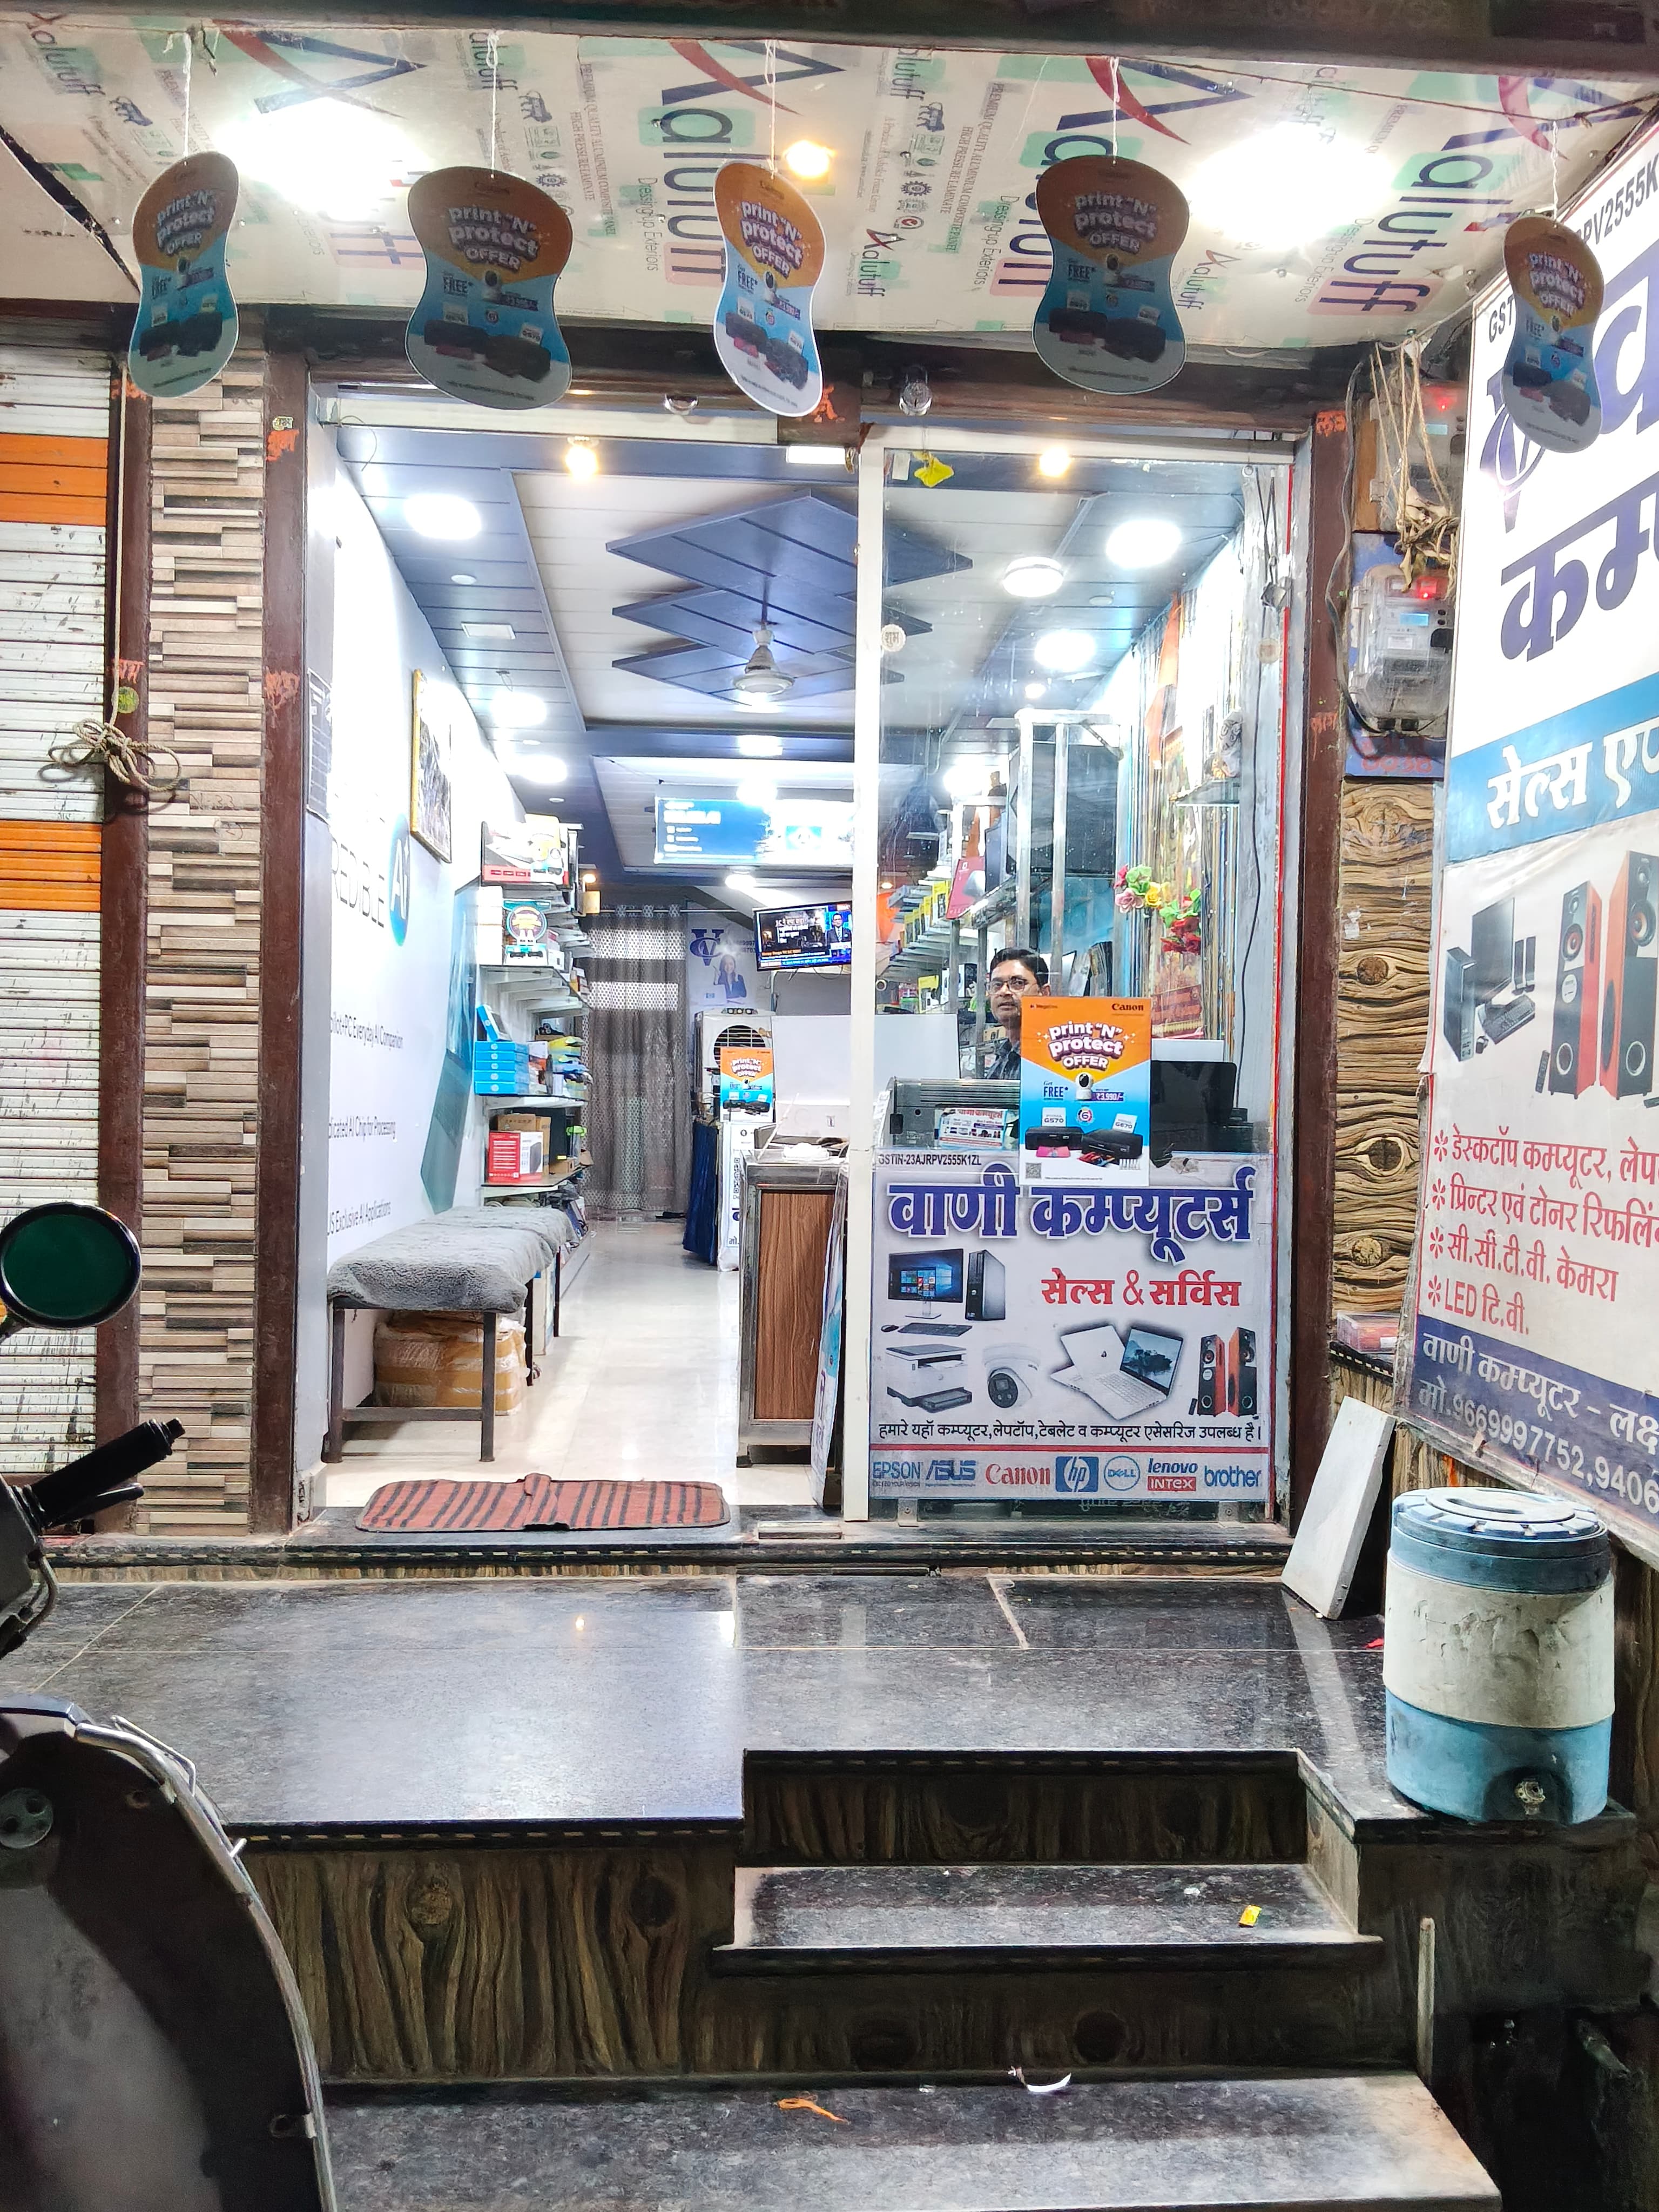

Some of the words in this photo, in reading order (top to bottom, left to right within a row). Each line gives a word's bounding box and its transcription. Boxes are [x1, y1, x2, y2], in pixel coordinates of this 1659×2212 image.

[448, 206, 502, 225] print
[741, 200, 778, 225] print
[1074, 192, 1123, 211] print
[1074, 212, 1158, 240] protect
[448, 226, 538, 259] protect
[741, 219, 803, 267] protect
[1089, 231, 1140, 252] OFFER
[465, 247, 521, 269] OFFER
[752, 245, 791, 275] OFFER
[1487, 740, 1593, 830] सेल्स
[1049, 1021, 1093, 1040] print
[1049, 1036, 1124, 1058] protect
[1063, 1055, 1109, 1069] OFFER
[879, 1154, 982, 1165] GSTIN-23AJRPV2555K1ZL
[1452, 1123, 1519, 1168] डेस्कटॉप
[1522, 1141, 1611, 1190] कम्प्यूटर,
[1620, 1136, 1659, 1185] लेप
[888, 1163, 1021, 1239] वाणी
[1029, 1164, 1257, 1266] कम्प्यूटर्स
[1449, 1172, 1498, 1217] प्रिन्टर
[1501, 1183, 1526, 1224] एवं
[1530, 1185, 1578, 1233] टोनर
[1041, 1267, 1115, 1305] सेल्स
[1123, 1270, 1144, 1305] &
[1149, 1270, 1242, 1306] सर्विस
[1556, 1245, 1619, 1301] केमरा
[1445, 1278, 1476, 1318] LED
[1423, 1333, 1475, 1377] वाणी
[1478, 1352, 1581, 1421] कम्प्यूटर
[878, 1419, 909, 1439] हमारे
[1078, 1425, 1087, 1437] व
[1090, 1425, 1141, 1442] कम्प्यूटर
[1144, 1421, 1195, 1441] एसेसरिज
[1199, 1426, 1242, 1440] उपलब्ध
[872, 1461, 921, 1479] EPSON
[925, 1460, 977, 1481] ASUS
[985, 1464, 1051, 1485] Canon
[1108, 1468, 1136, 1478] DELL
[1148, 1458, 1198, 1473] lenovo
[1204, 1466, 1262, 1487] brother
